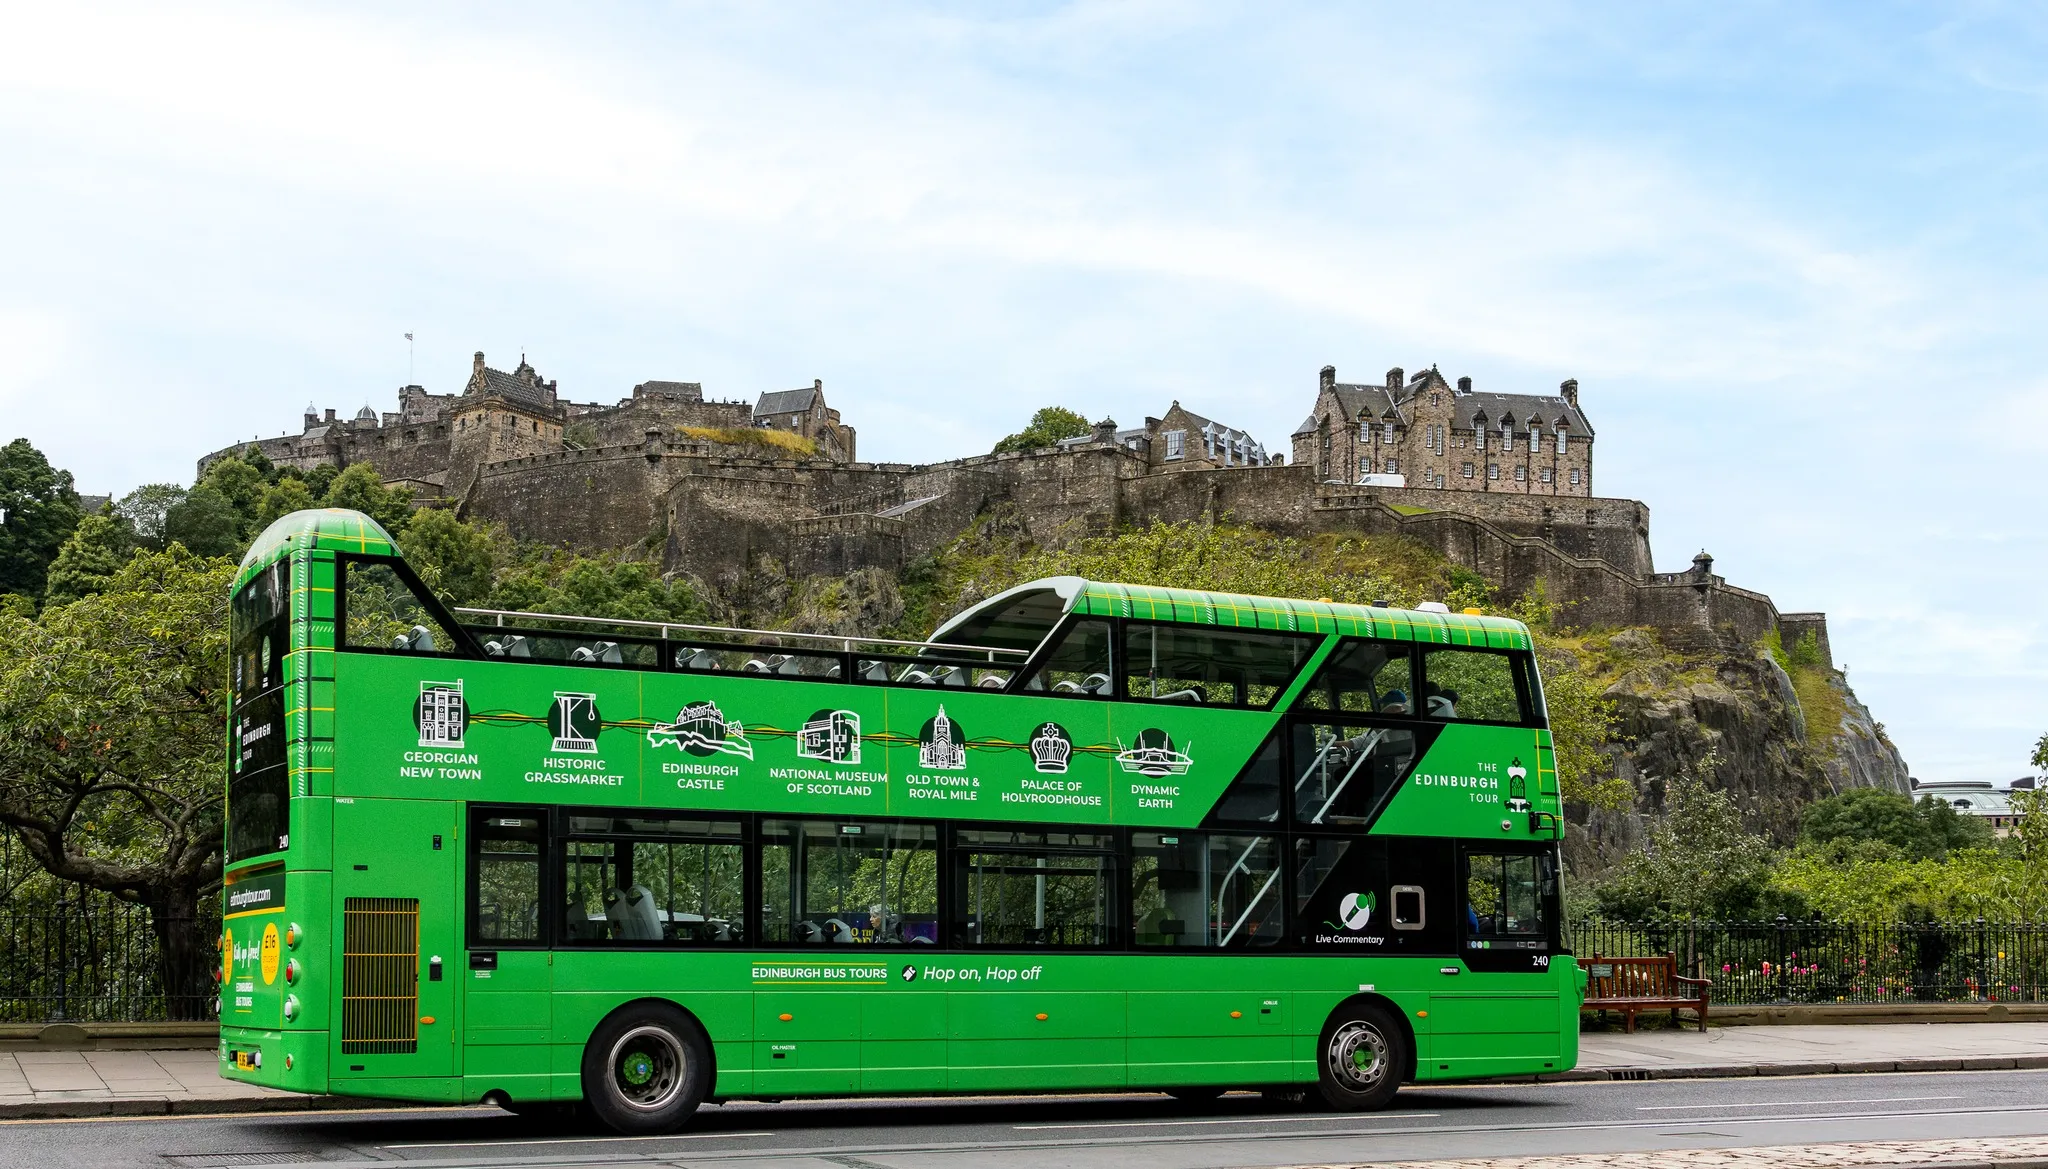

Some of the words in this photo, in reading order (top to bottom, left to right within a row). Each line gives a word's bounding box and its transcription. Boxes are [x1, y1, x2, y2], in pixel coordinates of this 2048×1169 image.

[243, 723, 271, 746] EDINBURGH
[403, 752, 479, 765] GEORGIAN
[543, 757, 606, 771] HISTORIC
[400, 766, 434, 778] NEW
[437, 767, 482, 780] TOWN
[662, 762, 739, 777] EDINBURGH
[1477, 762, 1497, 773] THE
[524, 771, 625, 786] GRASSMARKET
[769, 767, 833, 781] NATIONAL
[836, 771, 888, 784] MUSEUM
[905, 774, 931, 785] OLD
[933, 775, 969, 787] TOWN
[972, 777, 980, 787] &
[1415, 773, 1498, 789] EDINBURGH
[676, 778, 725, 790] CASTLE
[786, 782, 804, 794] OF
[806, 783, 872, 797] SCOTLAND
[1021, 779, 1065, 791] PALACE
[1067, 781, 1083, 792] OF
[1131, 784, 1180, 796] DYNAMIC
[909, 788, 947, 800] ROYAL
[950, 790, 978, 801] MILE
[1001, 793, 1102, 806] HOLYROODHOUSE
[1469, 792, 1499, 804] TOUR
[1138, 798, 1173, 809] EARTH
[278, 834, 289, 849] 240
[231, 889, 271, 908] edinburghtour.com
[265, 934, 276, 949] £16
[1315, 934, 1332, 944] Live
[1333, 934, 1385, 946] Commentary
[1532, 955, 1549, 967] 240
[751, 967, 821, 979] EDINBURGH
[823, 967, 847, 979] BUS
[848, 967, 888, 979] TOURS
[923, 966, 956, 983] Hop
[958, 968, 982, 982] on,
[986, 966, 1018, 983] Hop
[1021, 965, 1043, 980] off
